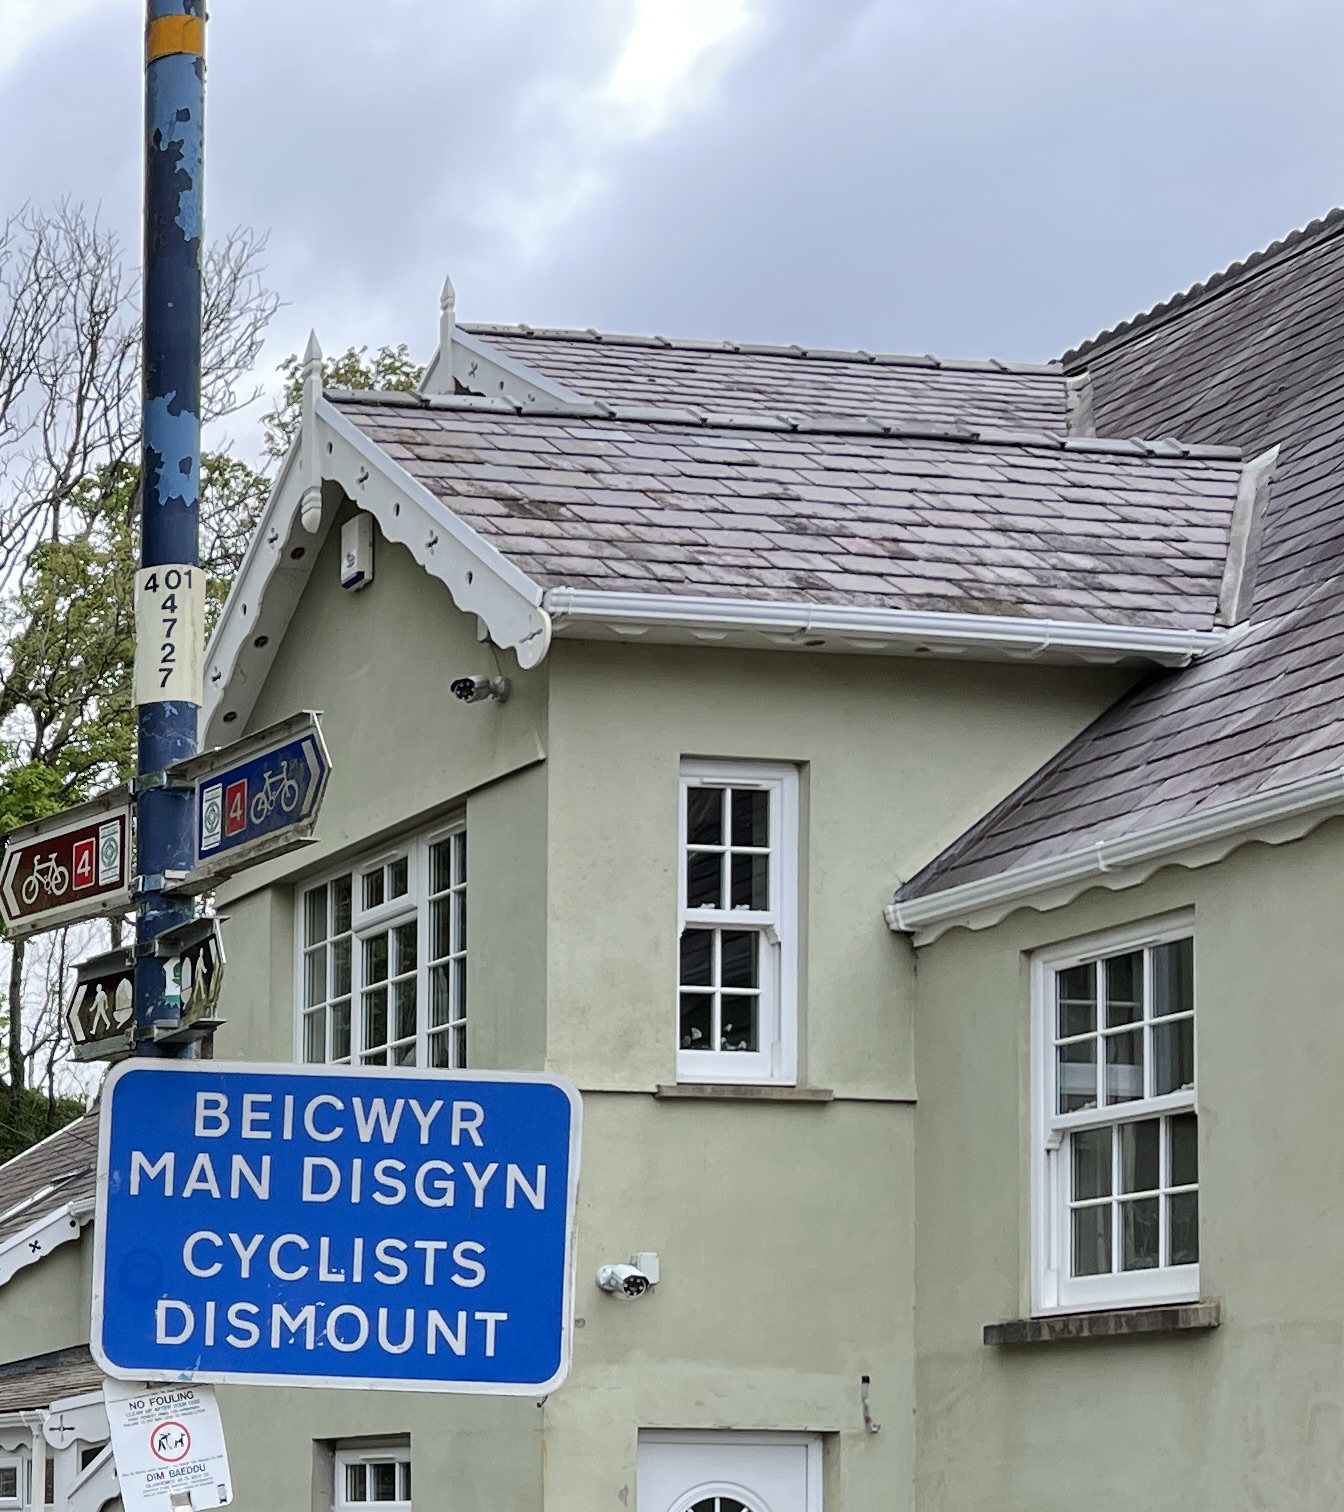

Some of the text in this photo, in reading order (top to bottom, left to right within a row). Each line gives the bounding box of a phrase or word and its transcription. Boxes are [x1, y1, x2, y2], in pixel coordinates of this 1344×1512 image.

[144, 569, 192, 593] 401
[230, 792, 243, 821] 4
[76, 849, 91, 877] 4
[195, 1091, 486, 1147] BEICWYR
[129, 1151, 547, 1211] MAN DISGYN
[183, 1230, 487, 1288] CYCLISTS
[155, 1299, 509, 1358] DISMOUNT
[128, 1400, 145, 1411] NO
[149, 1390, 194, 1407] FOULING
[146, 1471, 165, 1483] DIM
[169, 1463, 206, 1478] BAEDDU
